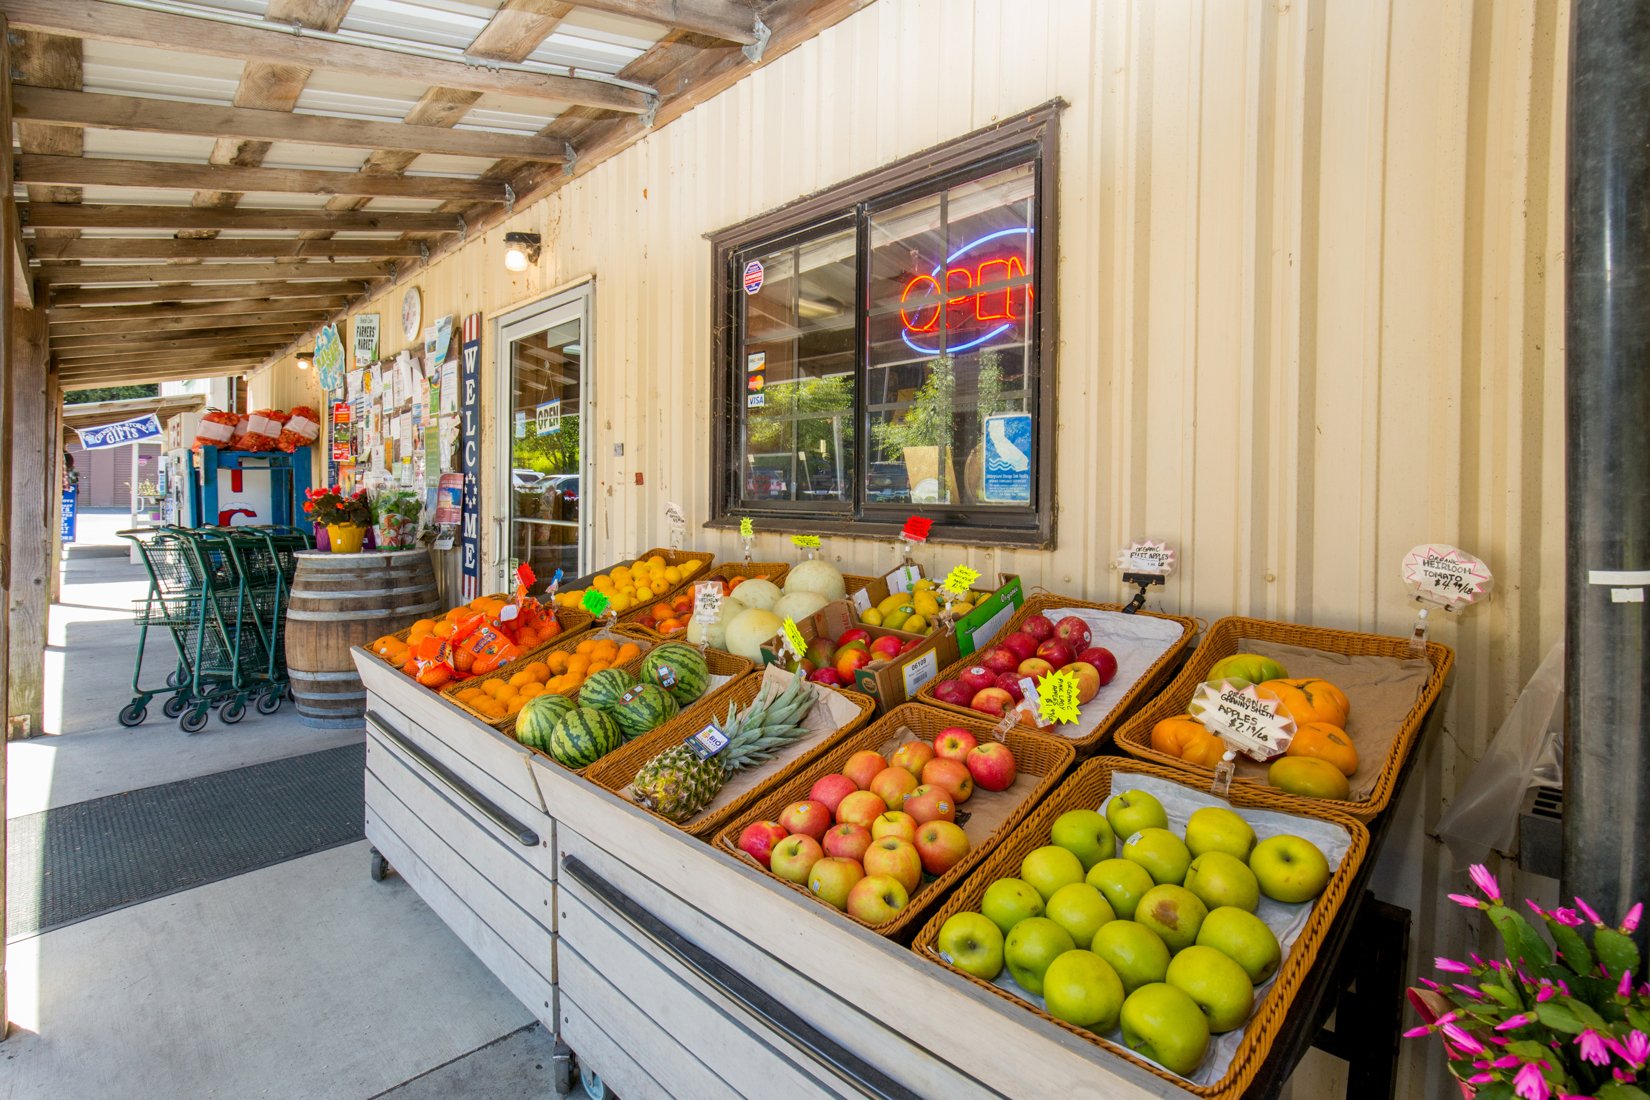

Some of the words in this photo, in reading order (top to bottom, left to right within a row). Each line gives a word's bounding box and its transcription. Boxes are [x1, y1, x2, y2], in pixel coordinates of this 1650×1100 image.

[900, 256, 1034, 332] OPEN
[749, 395, 764, 405] VISA
[537, 404, 559, 431] OPEN
[106, 426, 139, 444] GIFTS
[1422, 558, 1473, 575] HEIRLOOM
[1423, 569, 1463, 582] TOMATO
[1058, 694, 1066, 711] LADY
[1220, 693, 1252, 711] GRANNY
[1251, 704, 1275, 720] SMITH
[1227, 689, 1270, 711] ORGANIC
[1217, 703, 1259, 726] APPLES
[708, 734, 722, 747] BIO
